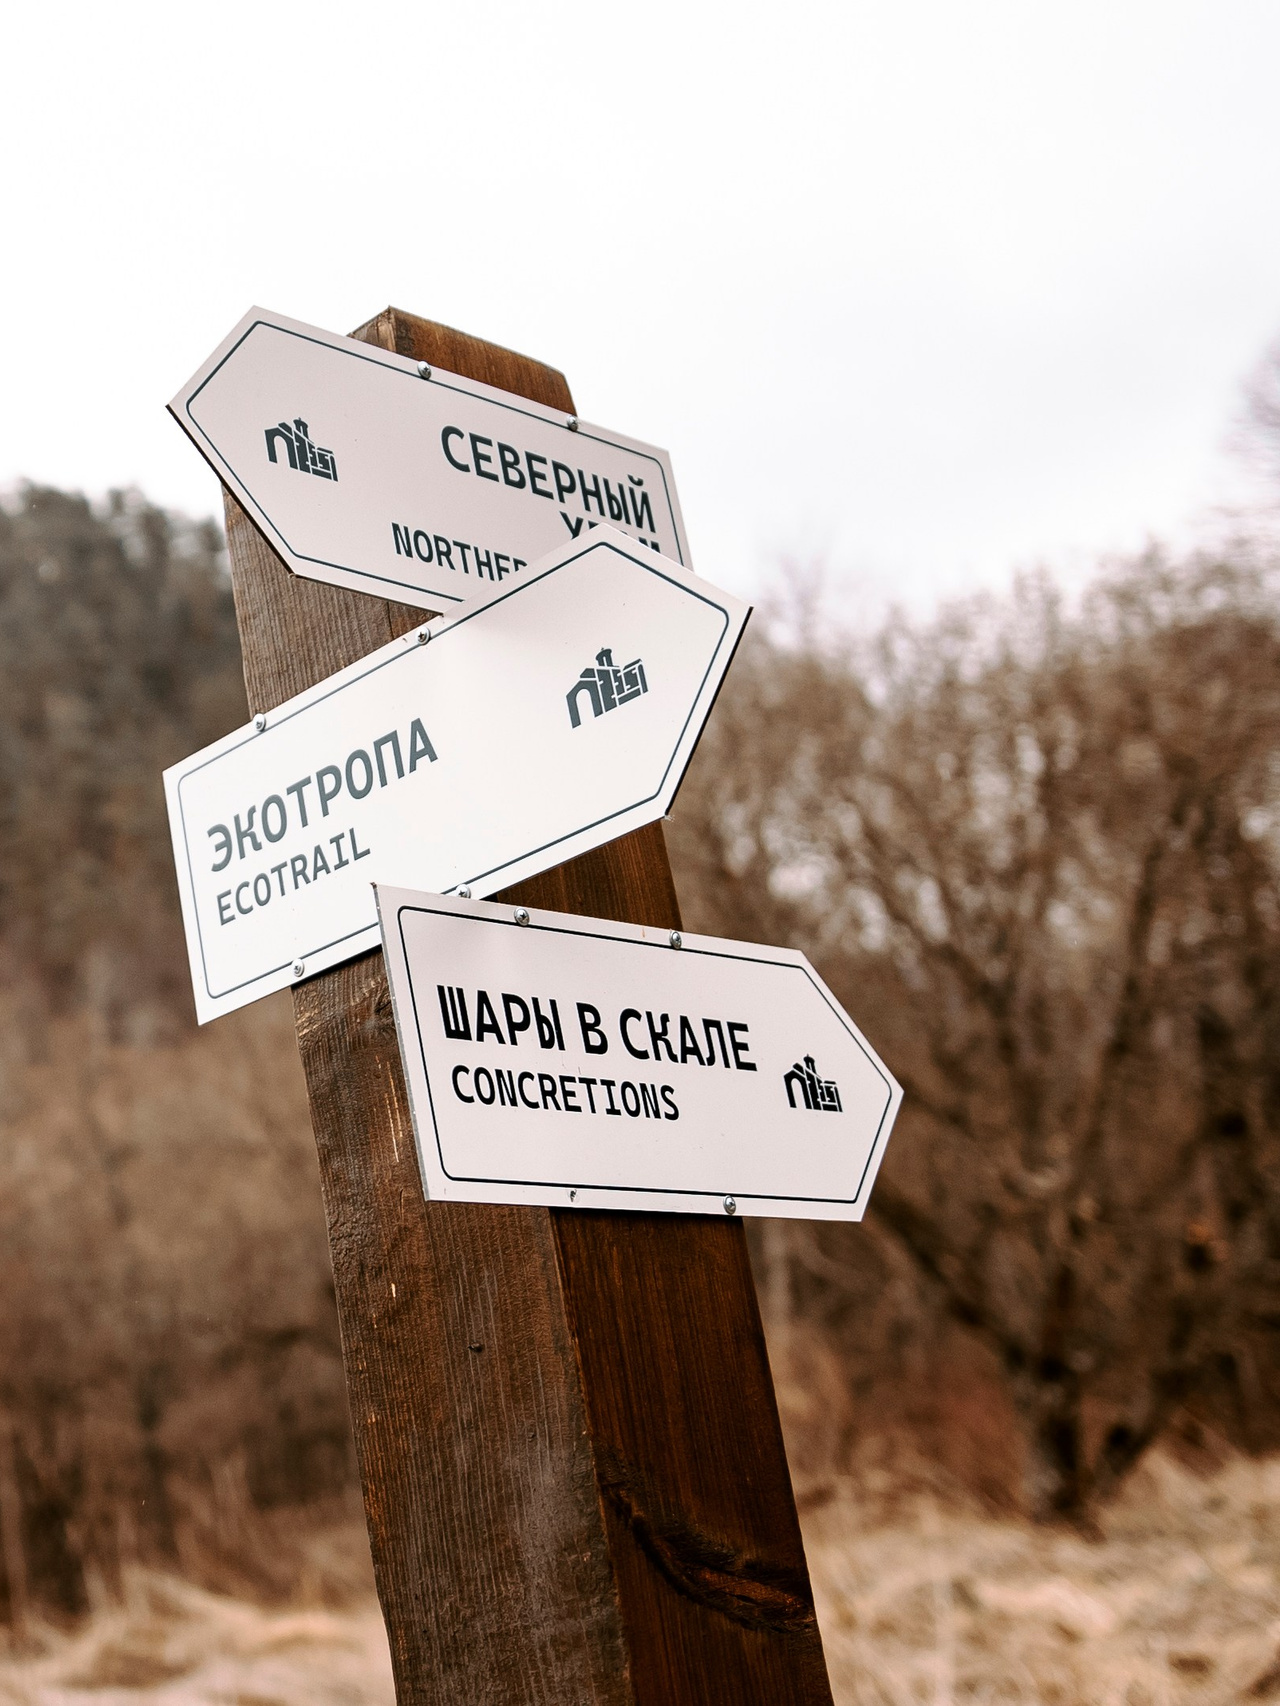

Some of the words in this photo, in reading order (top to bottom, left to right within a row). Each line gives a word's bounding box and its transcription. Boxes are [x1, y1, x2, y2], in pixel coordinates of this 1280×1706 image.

[440, 425, 657, 533] СЕВЕРНЫЙ
[207, 717, 438, 873] ЭКОТРОПА
[216, 827, 371, 926] ECOTRAIL
[436, 984, 566, 1051] ШАРЫ
[576, 1001, 609, 1056] В
[619, 1007, 758, 1072] СКАЛЕ
[451, 1064, 680, 1121] CONCRETIONS
